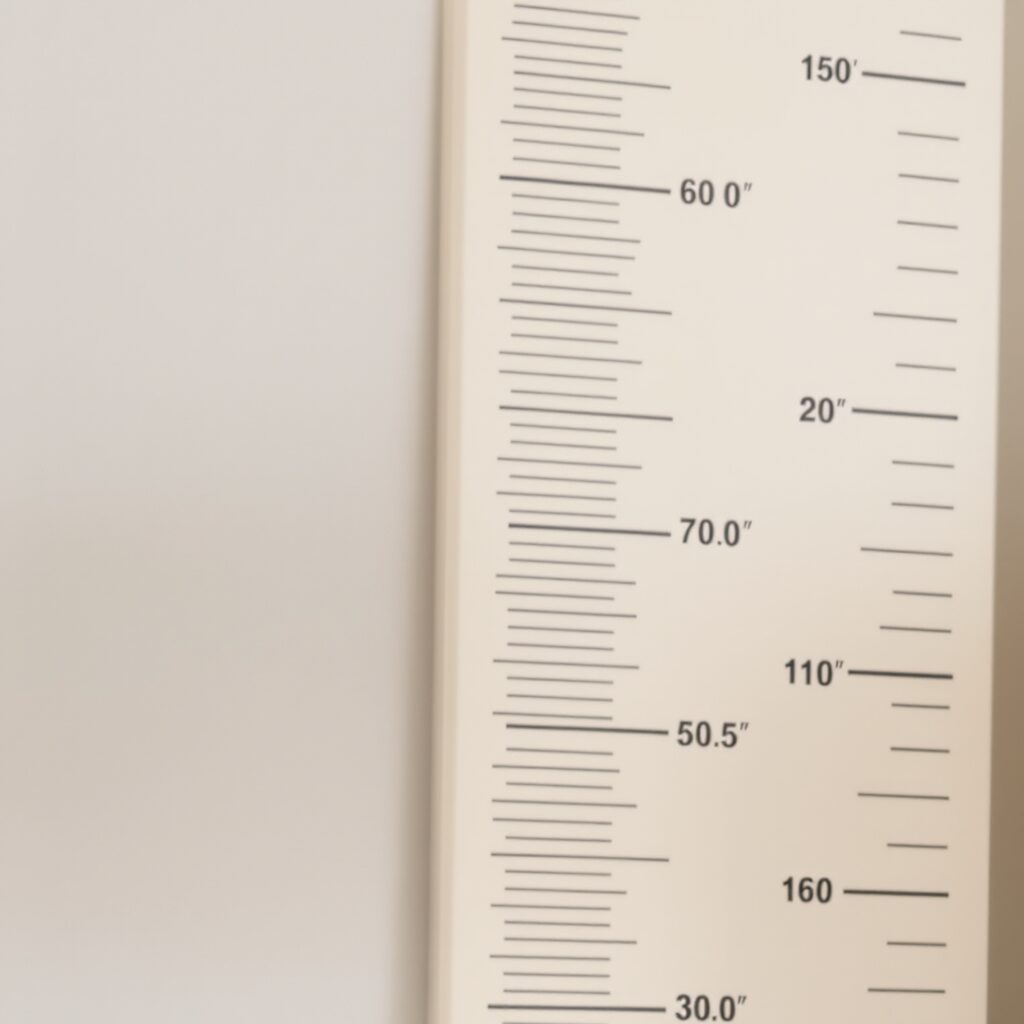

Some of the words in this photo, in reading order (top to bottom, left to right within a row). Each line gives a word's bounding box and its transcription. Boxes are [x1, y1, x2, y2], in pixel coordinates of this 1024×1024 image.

[798, 396, 847, 424] 20"
[680, 517, 753, 547] 70.0"
[784, 658, 844, 687] 110"
[676, 720, 750, 748] 50.5"
[781, 876, 834, 904] 160
[674, 994, 748, 1022] 30.0"
